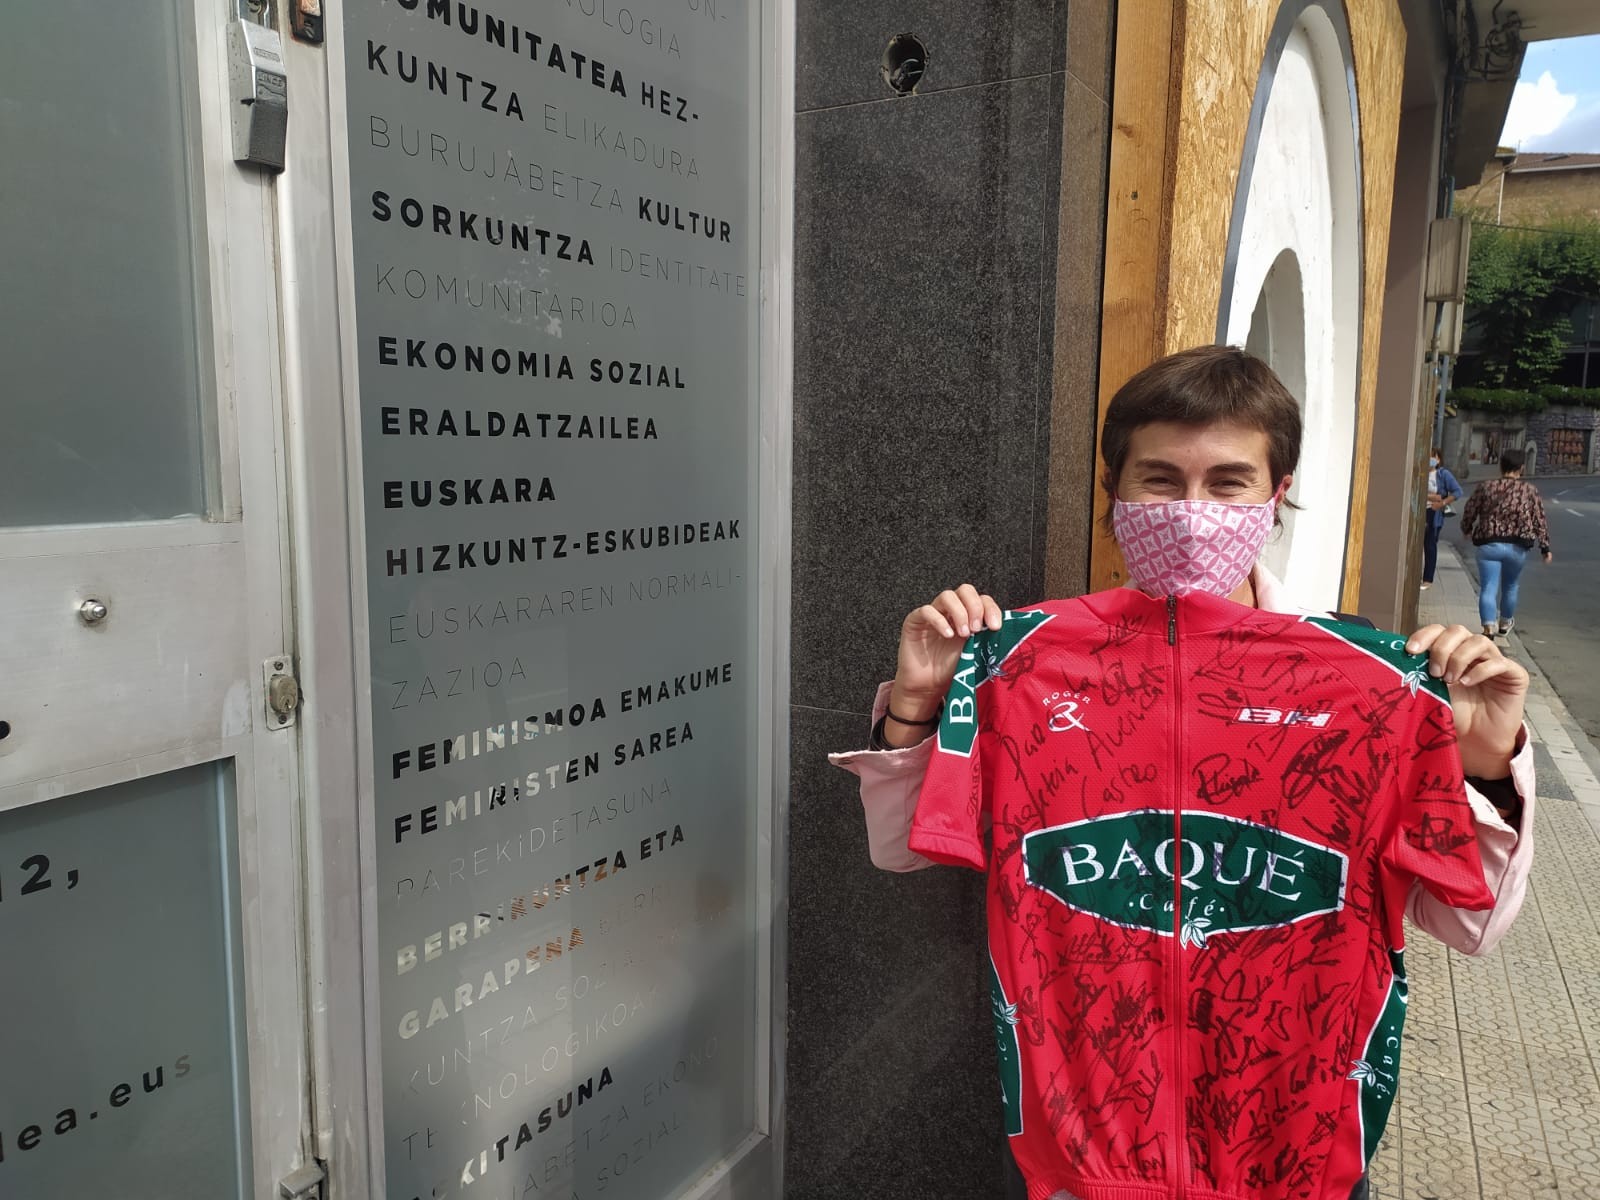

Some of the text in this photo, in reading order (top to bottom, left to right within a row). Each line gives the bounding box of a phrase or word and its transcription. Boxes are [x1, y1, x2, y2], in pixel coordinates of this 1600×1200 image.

[566, 0, 681, 60] OLOGIA
[367, 39, 699, 180] KUNTZA ELIKADURA
[641, 81, 699, 122] HEZ-
[370, 115, 731, 243] BURUJABETZA KULTUR
[371, 190, 746, 297] SORKUNTZA IDENTITATE
[376, 263, 637, 329] KOMUNITARIOA
[378, 336, 685, 389] EKONOMIA SOZIAL
[381, 406, 658, 440] ERALDATZAILEA
[384, 477, 556, 509] EUSKARA
[386, 519, 740, 577] HIZKUNTZ-ESKUBIDEAK
[389, 585, 614, 644] EUSKARAREN
[391, 657, 526, 710] ZAZIOA
[392, 663, 733, 780] FEMINISMOA EMAKUME
[1236, 707, 1333, 728] BH
[395, 722, 693, 844] FEMINISTEN SAREA
[0, 854, 79, 902] 2,
[397, 850, 627, 975] BERRIKUNTZA
[640, 825, 684, 860] ETA
[1061, 838, 1305, 901] BAQUÉ
[399, 926, 585, 1040] GARAPENA
[0, 1054, 191, 1164] ea.eus
